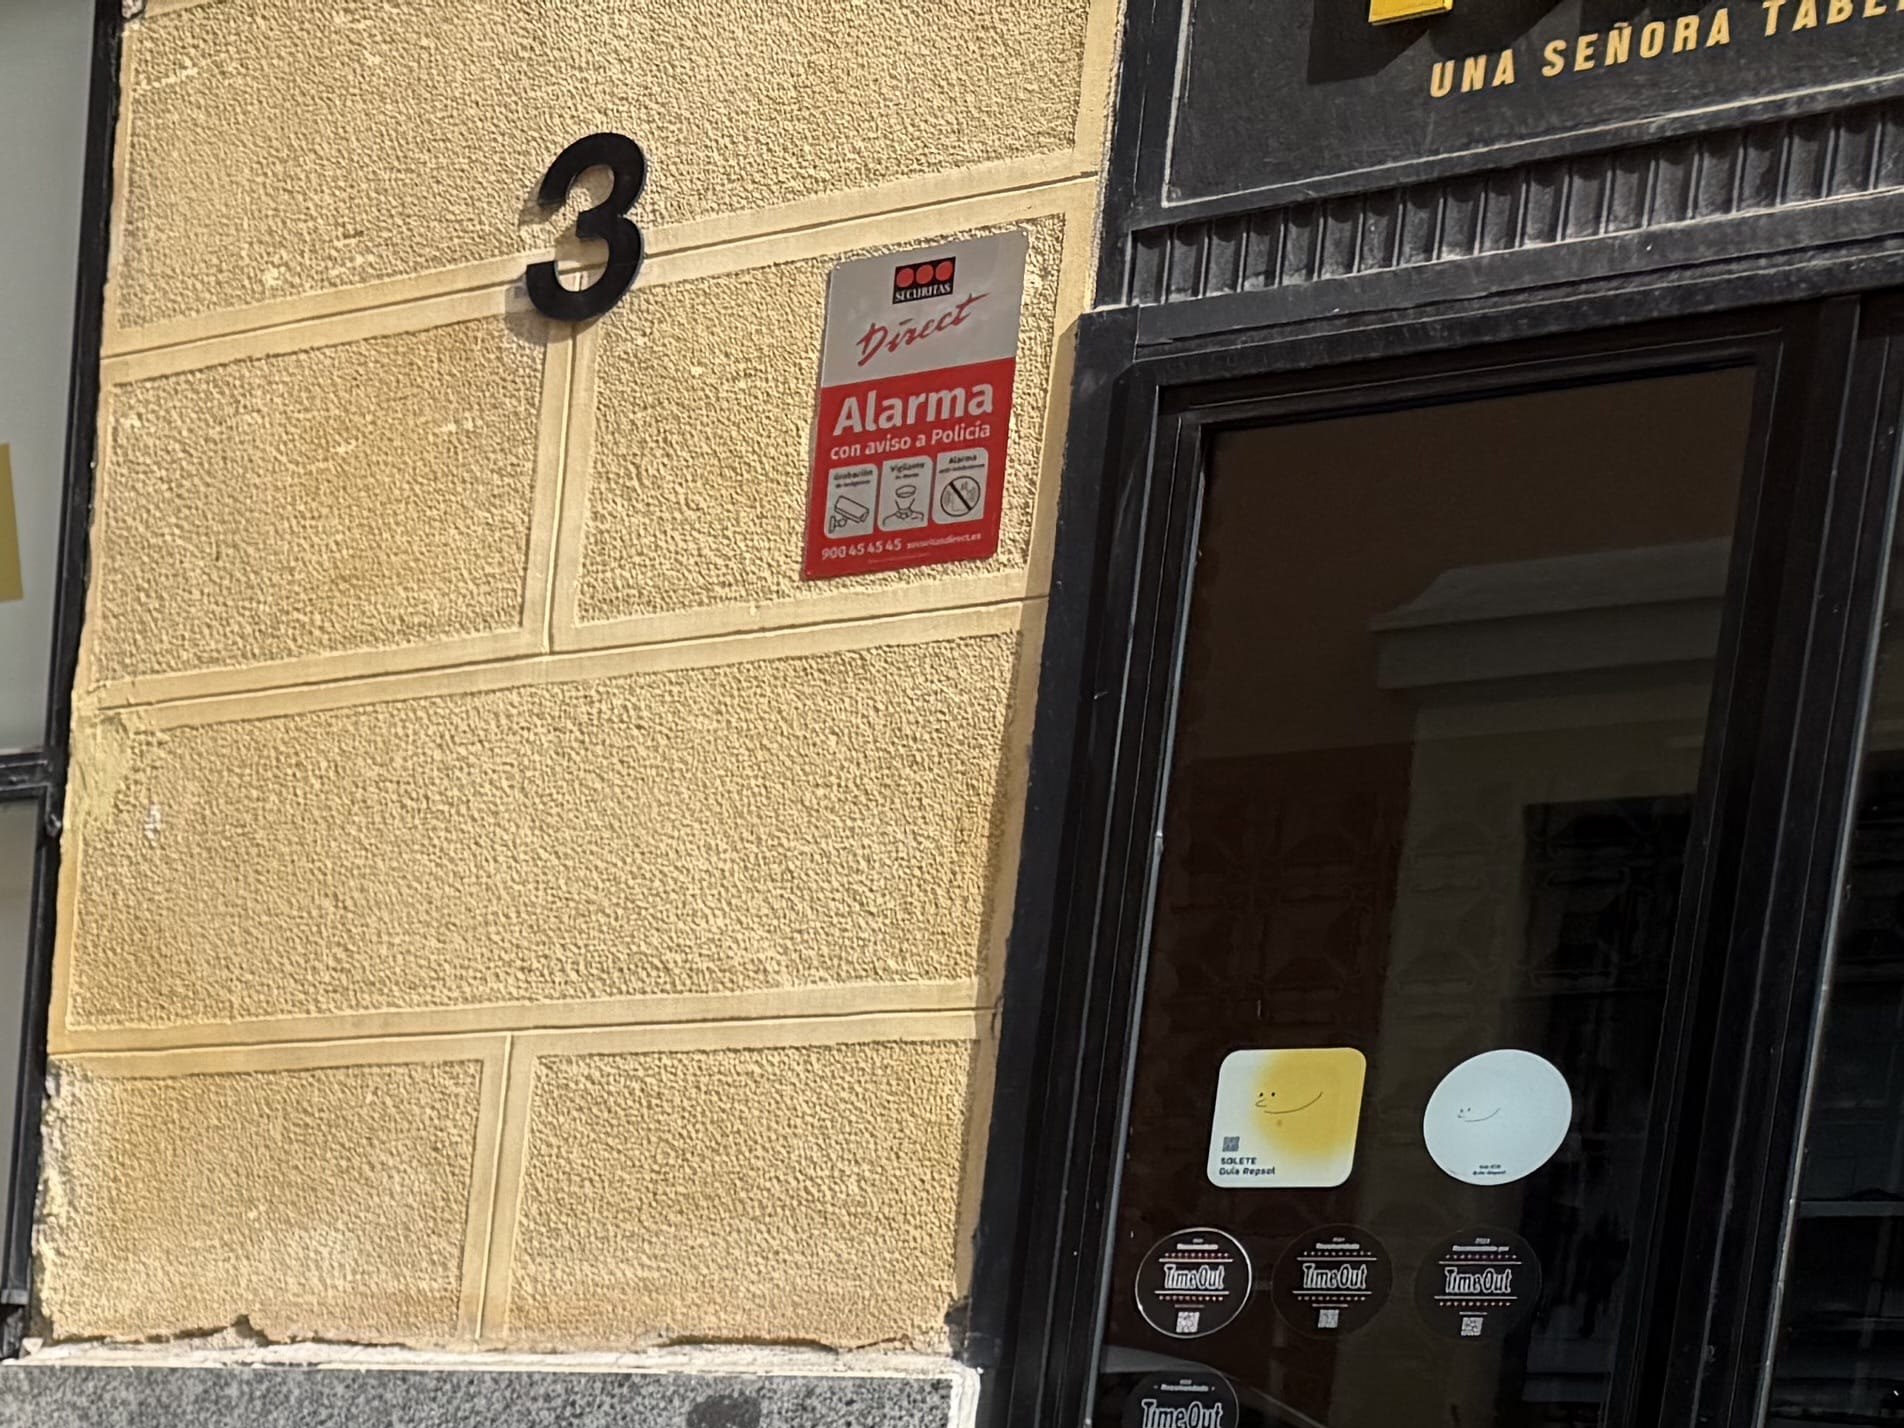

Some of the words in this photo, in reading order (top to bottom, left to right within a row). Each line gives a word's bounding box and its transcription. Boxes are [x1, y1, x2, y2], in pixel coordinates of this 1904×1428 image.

[1429, 48, 1516, 98] UNA
[1541, 7, 1732, 77] SEÑORA
[1761, 0, 1904, 37] TABE
[526, 132, 647, 322] 3
[894, 283, 952, 303] SECURITAS
[856, 291, 991, 367] Direct
[832, 383, 994, 437] Alarma
[830, 445, 861, 460] con
[865, 434, 911, 456] aviso
[915, 434, 926, 448] a
[931, 420, 991, 446] Policía
[821, 547, 847, 560] 900
[848, 542, 865, 556] 45
[867, 540, 883, 553] 45
[885, 538, 902, 551] 45
[1221, 1157, 1257, 1165] SOLETE
